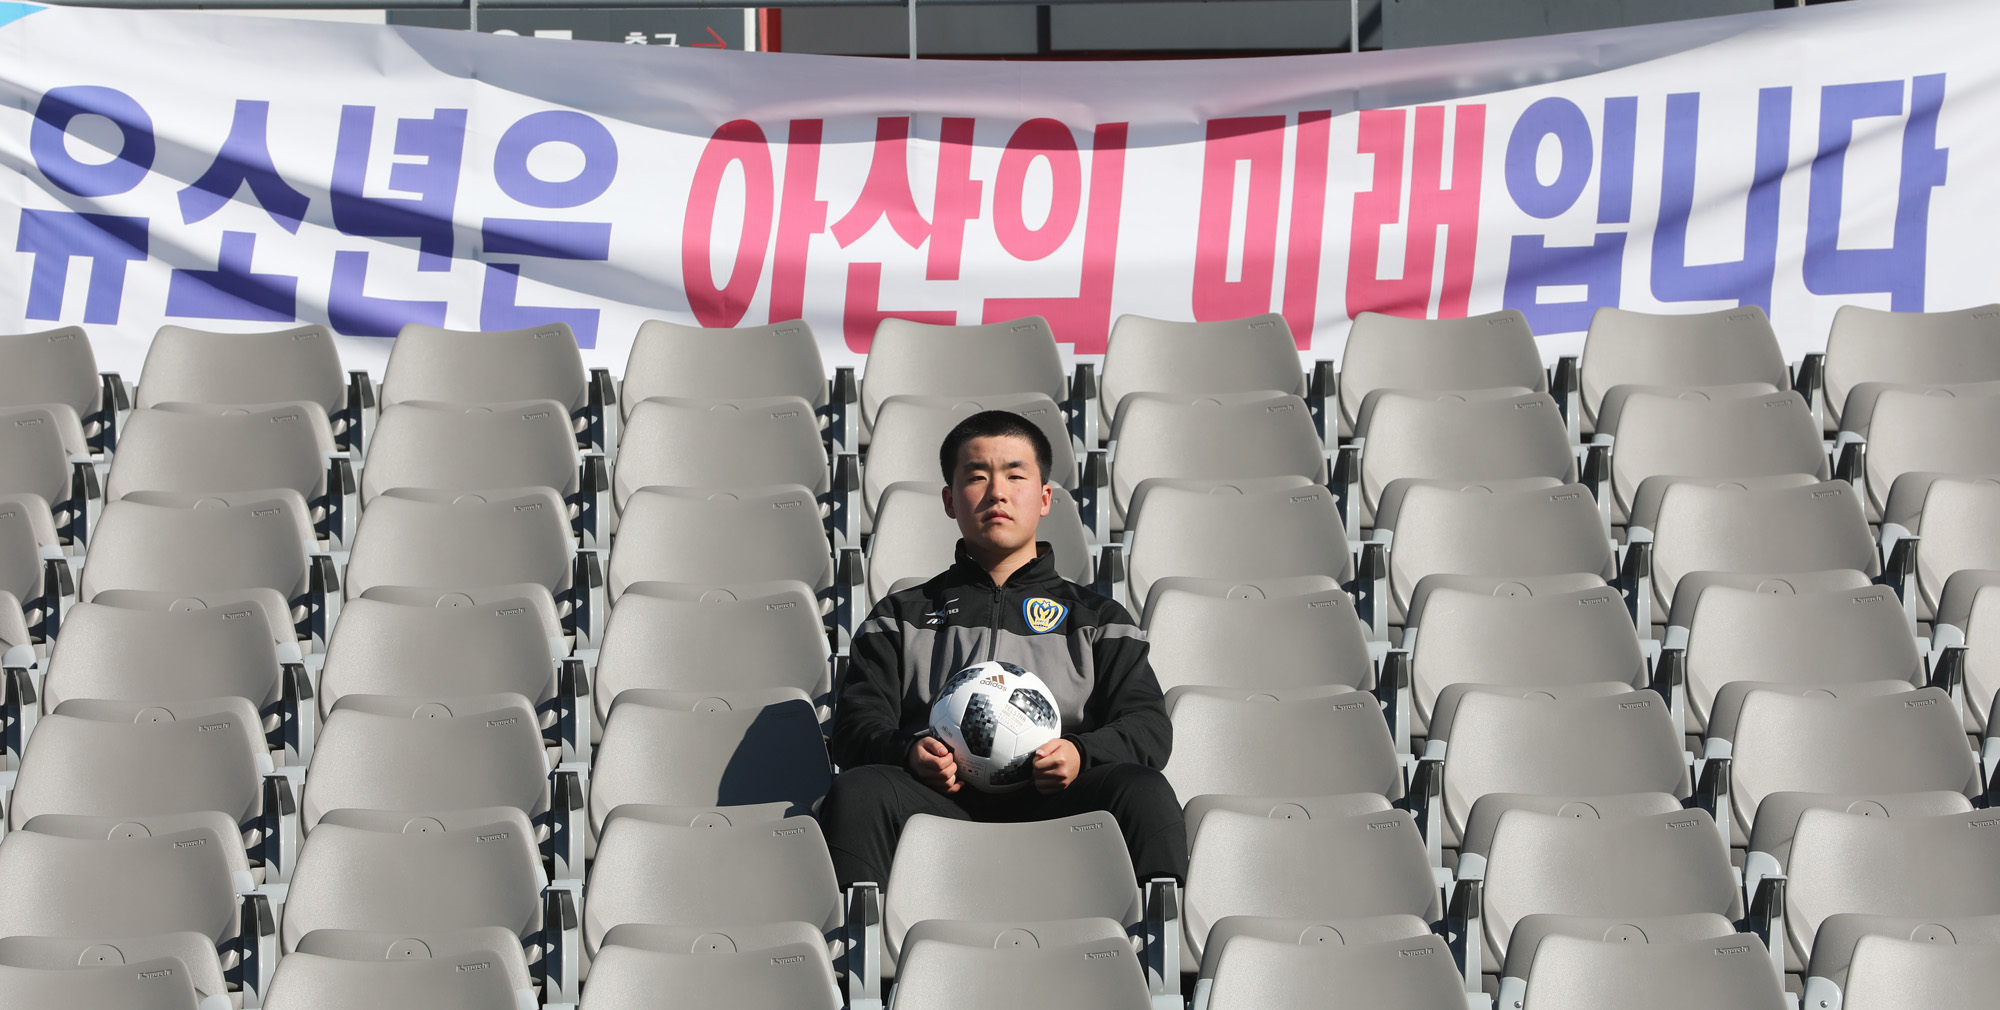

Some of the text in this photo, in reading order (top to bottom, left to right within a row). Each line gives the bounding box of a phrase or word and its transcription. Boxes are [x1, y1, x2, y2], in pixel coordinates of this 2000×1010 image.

[16, 72, 1949, 355] 유소년은 아산의 미래입니다
[979, 679, 1008, 692] adidas
